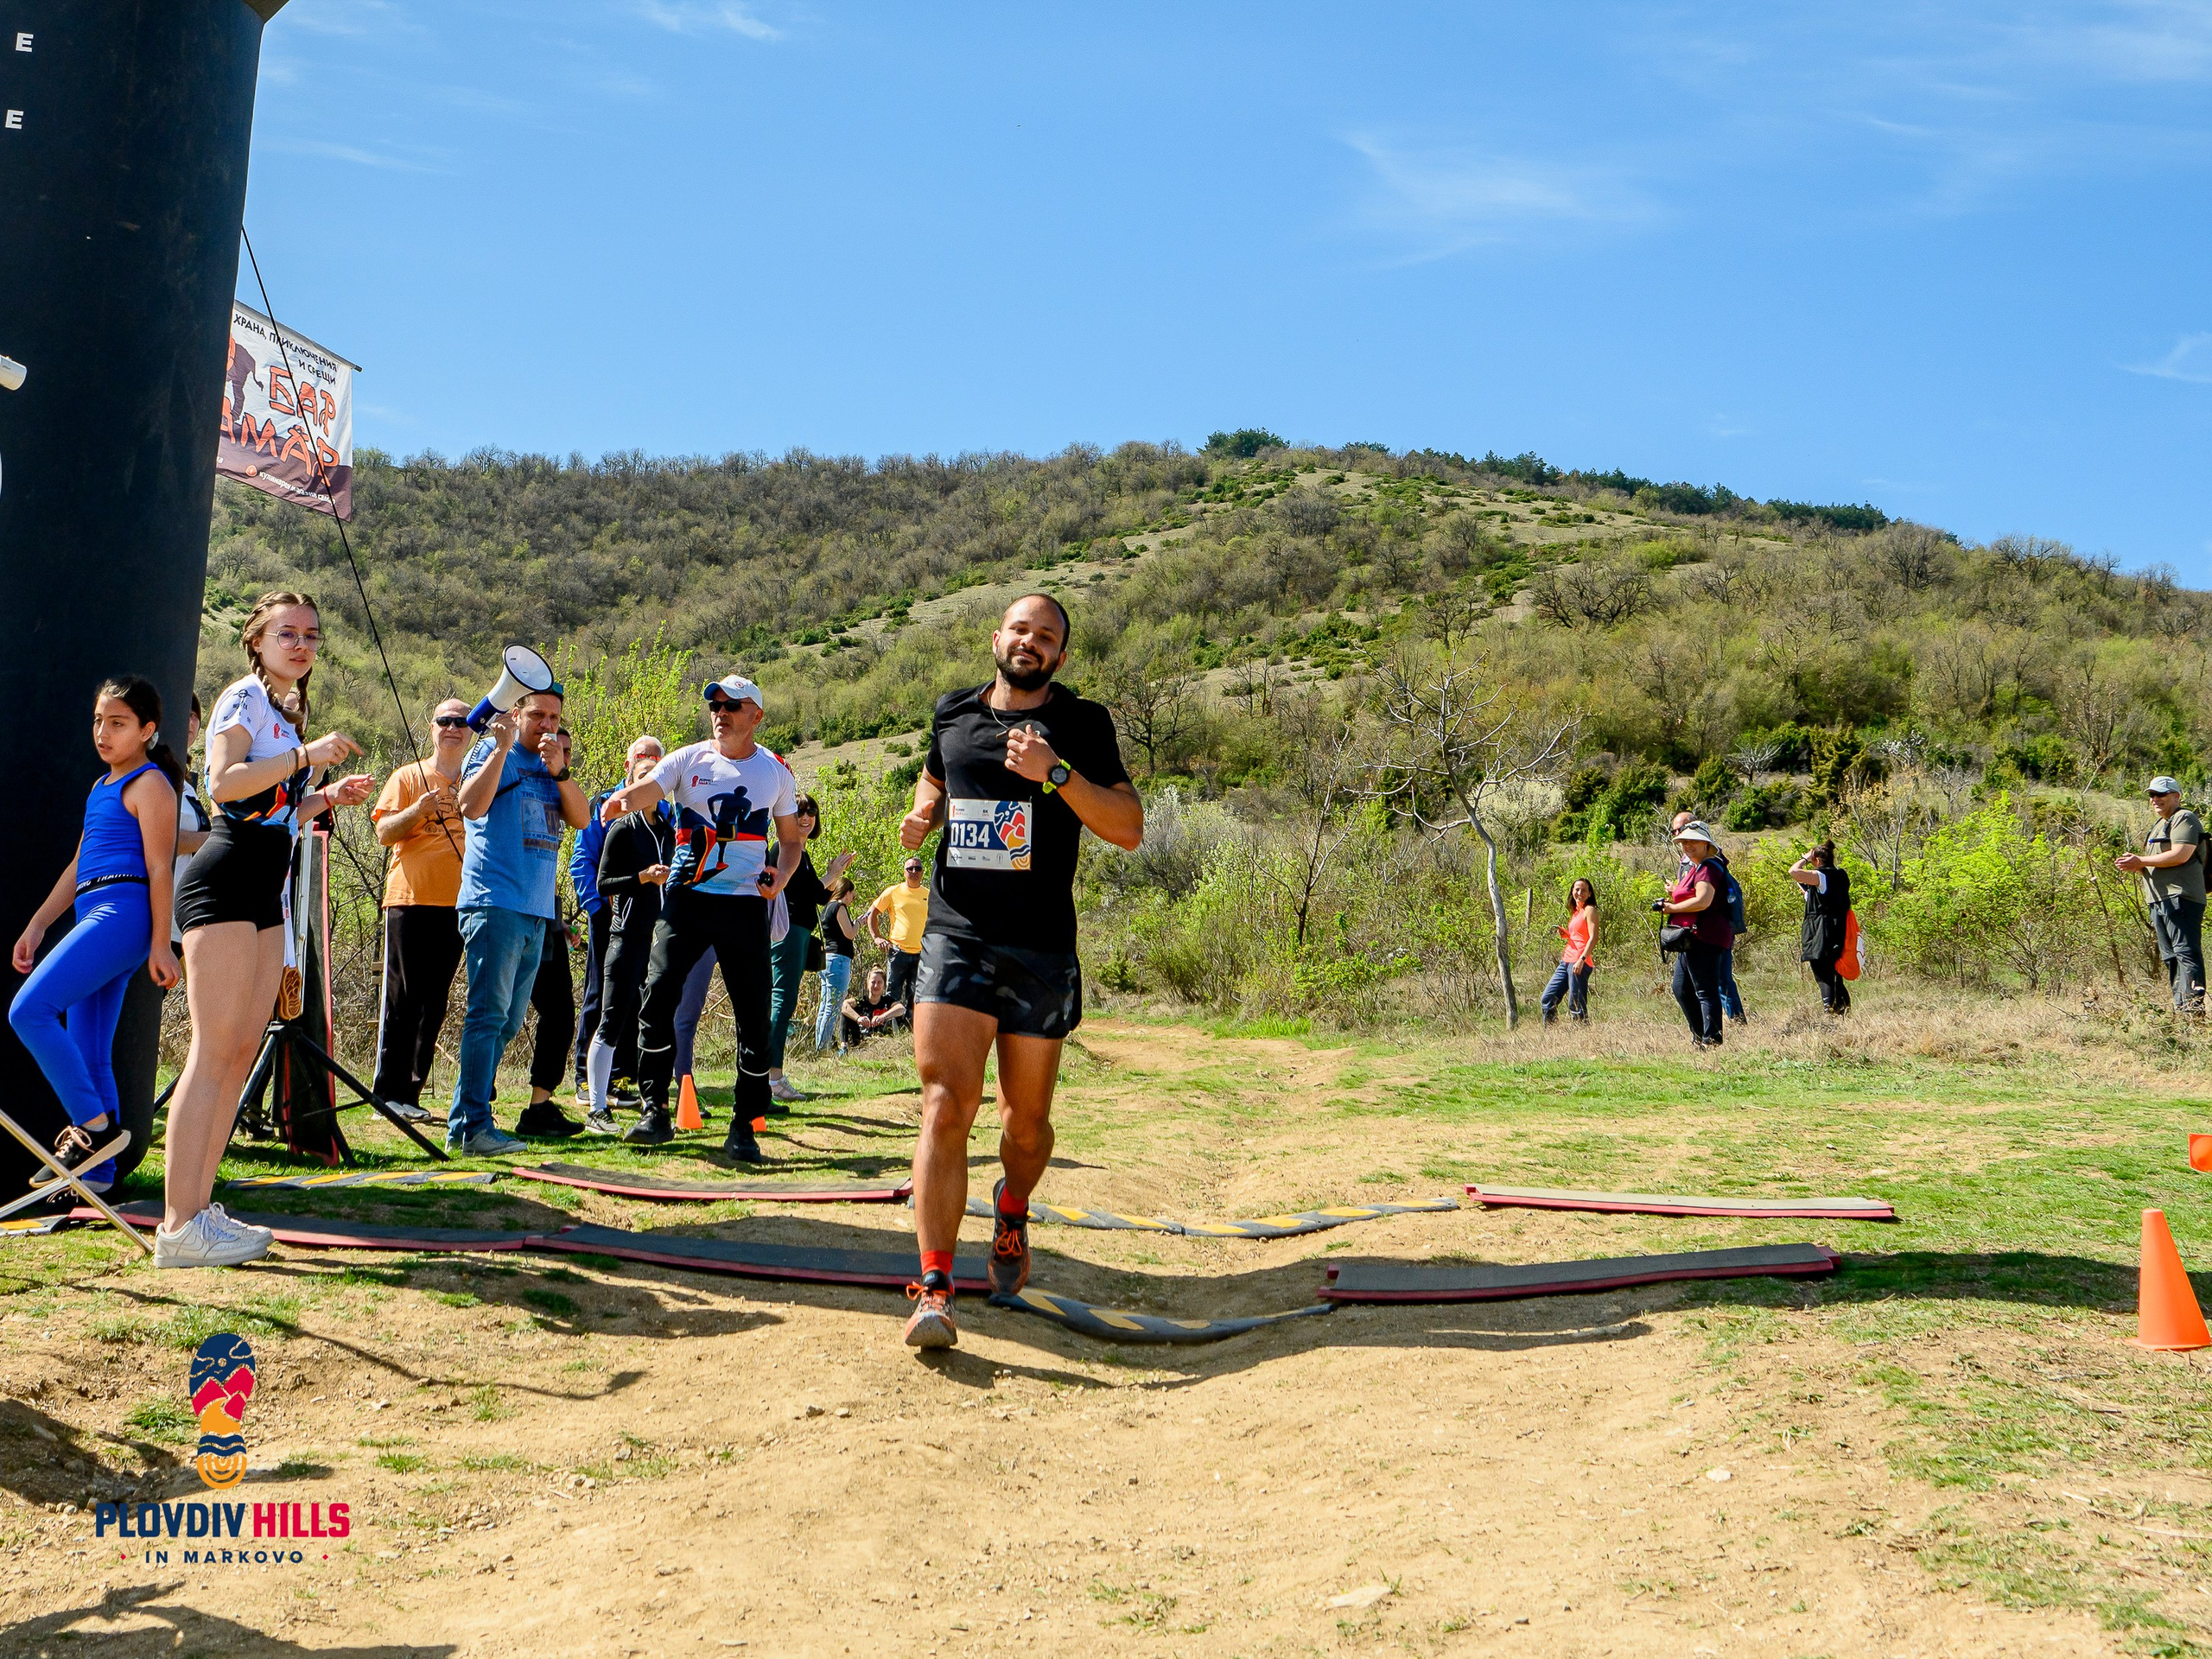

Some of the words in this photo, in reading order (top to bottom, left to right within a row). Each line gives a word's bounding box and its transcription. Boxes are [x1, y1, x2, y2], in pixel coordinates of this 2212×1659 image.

[233, 314, 266, 340] ХРАНА,
[298, 359, 306, 370] И
[308, 364, 336, 387] СРЕЩИ
[269, 365, 336, 436] БАР
[950, 823, 990, 848] 0134
